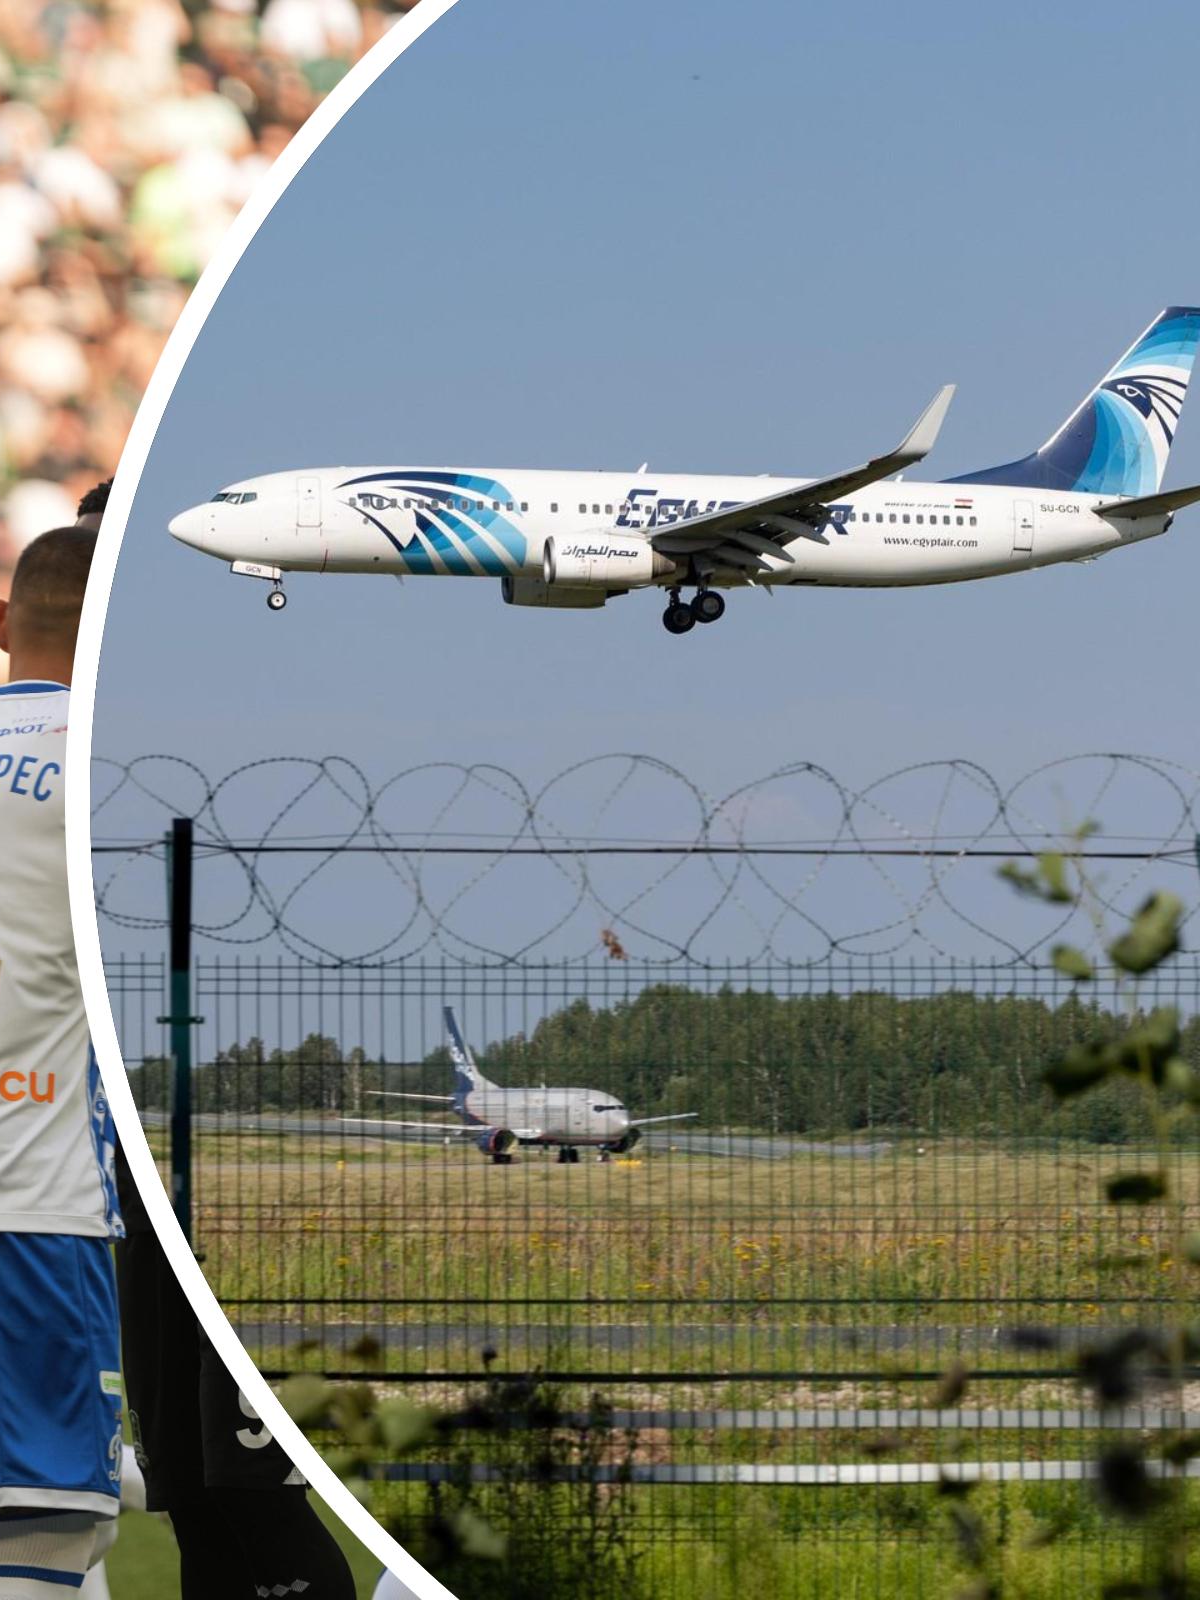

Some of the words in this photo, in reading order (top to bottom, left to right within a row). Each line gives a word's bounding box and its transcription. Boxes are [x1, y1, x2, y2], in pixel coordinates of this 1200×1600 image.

[1040, 504, 1080, 514] SU-GCN
[884, 537, 978, 548] www.egyptair.com
[561, 545, 609, 558] للطيران
[607, 549, 639, 558] مصر
